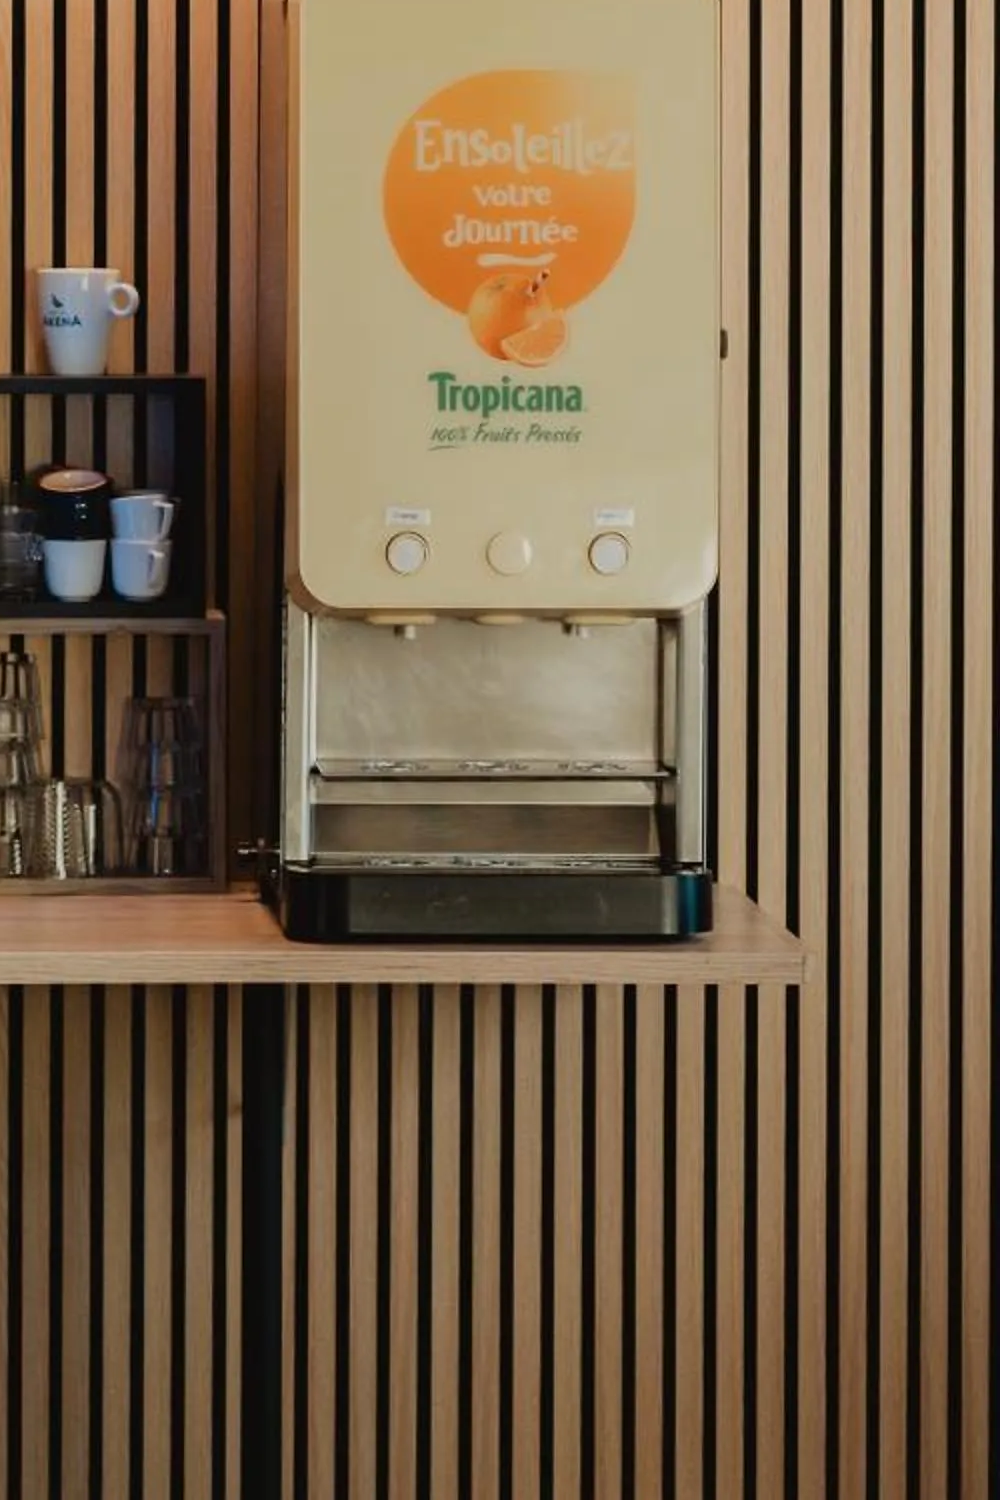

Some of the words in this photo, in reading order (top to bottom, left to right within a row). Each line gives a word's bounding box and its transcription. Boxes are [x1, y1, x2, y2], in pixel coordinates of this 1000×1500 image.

[414, 119, 633, 175] Ensoleillez
[473, 184, 552, 206] votre
[428, 371, 583, 419] Tropicana
[473, 421, 521, 443] Fruits
